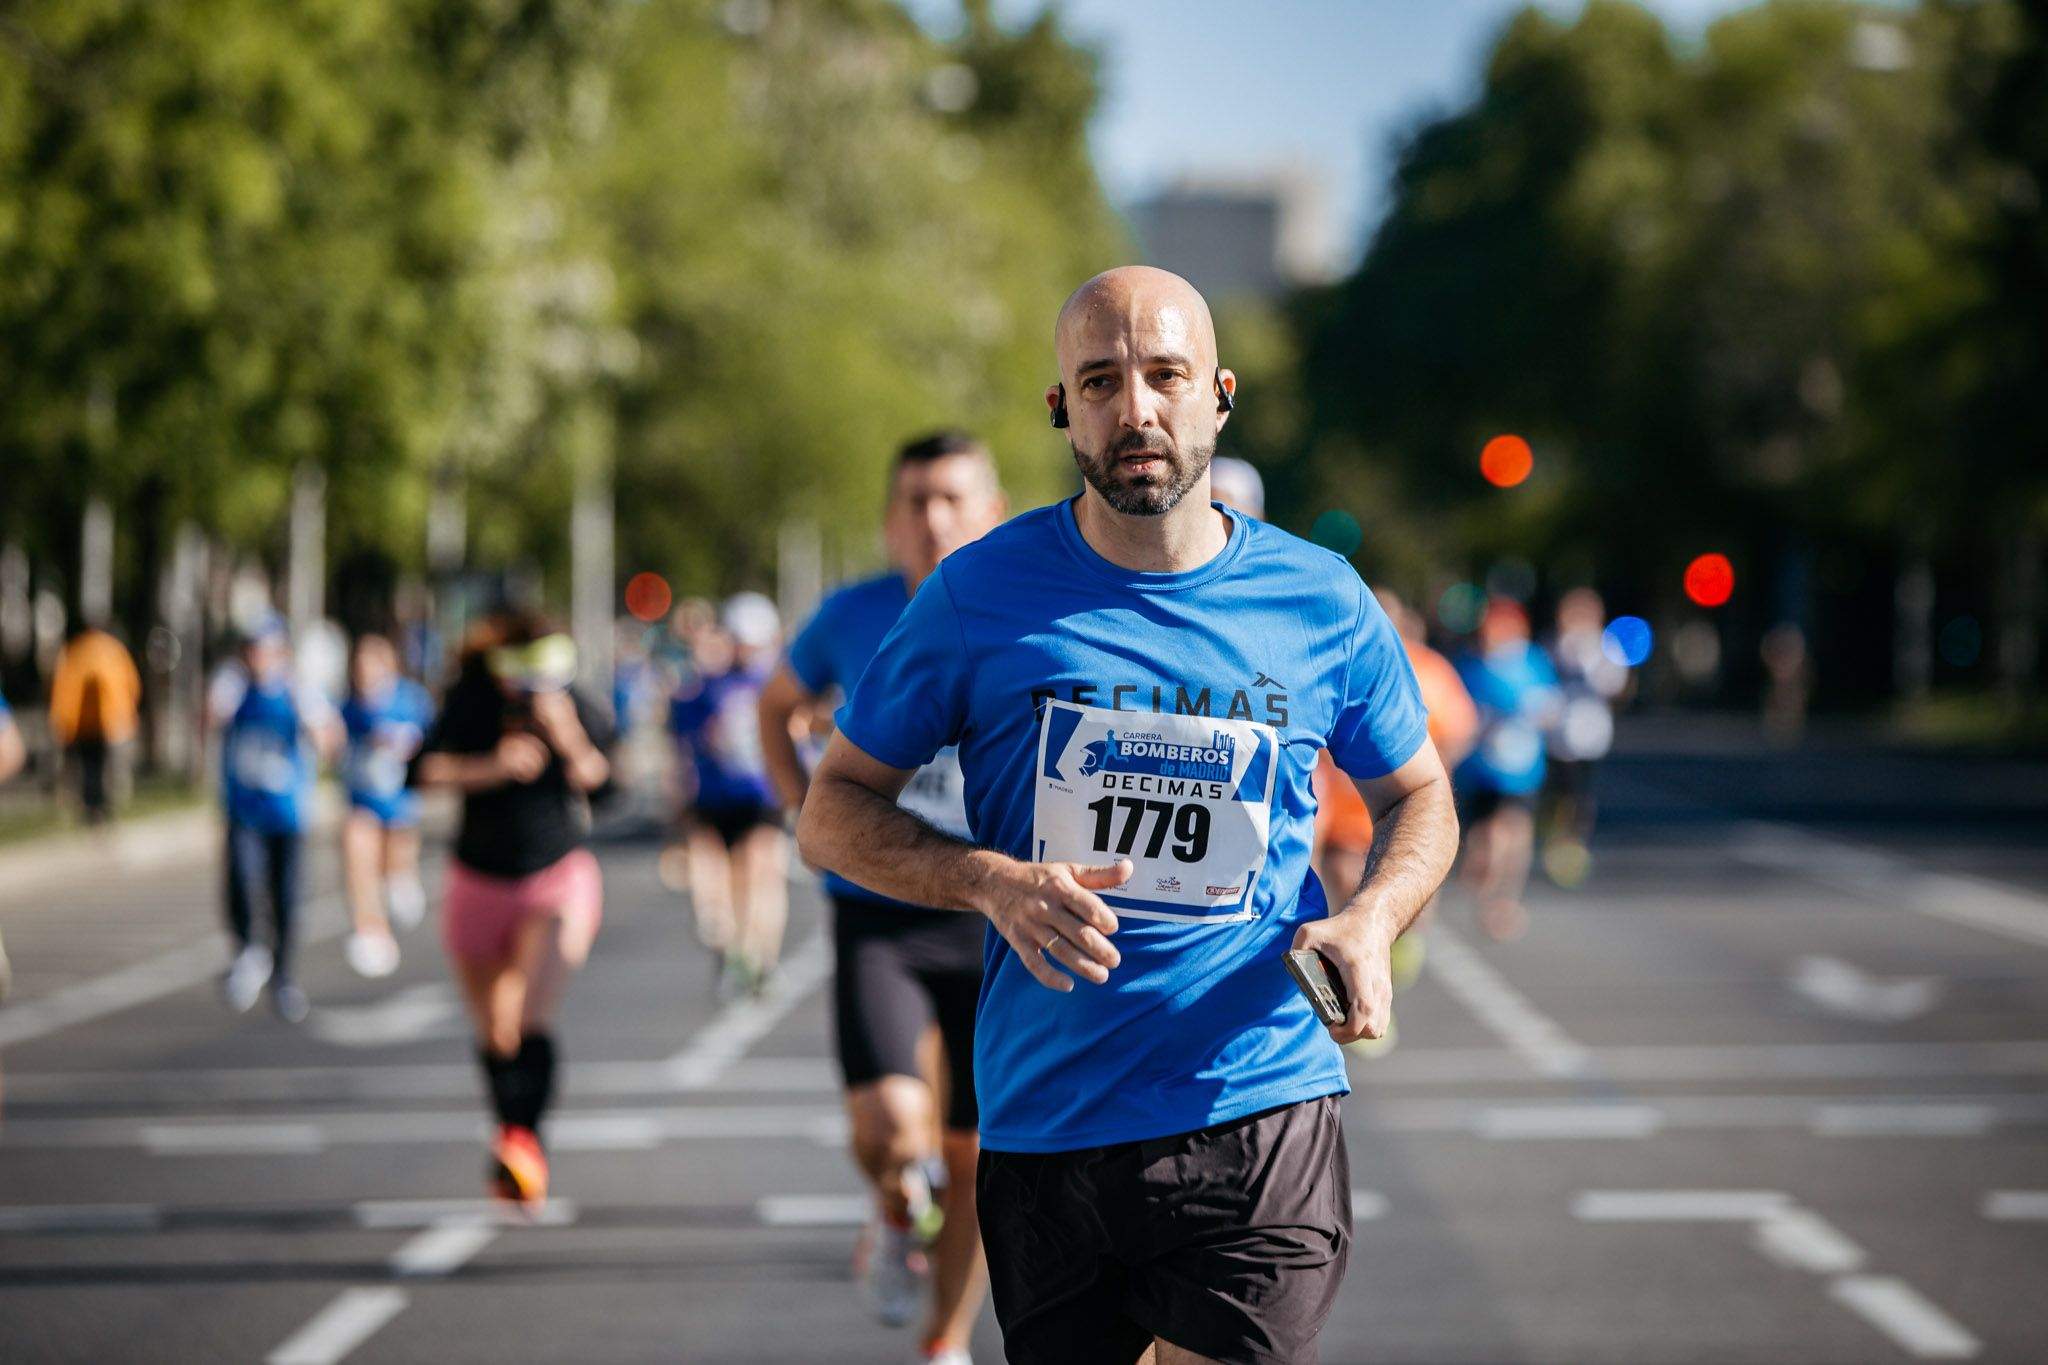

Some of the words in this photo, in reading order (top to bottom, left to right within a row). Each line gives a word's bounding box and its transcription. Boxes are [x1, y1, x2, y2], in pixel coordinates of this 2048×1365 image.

[1123, 732, 1163, 741] CARRERA
[1120, 741, 1230, 766] BOMBEROS
[1159, 759, 1176, 776] de
[1179, 761, 1229, 781] MADRID
[1102, 773, 1223, 800] DECIMAS
[1087, 795, 1212, 864] 1779
